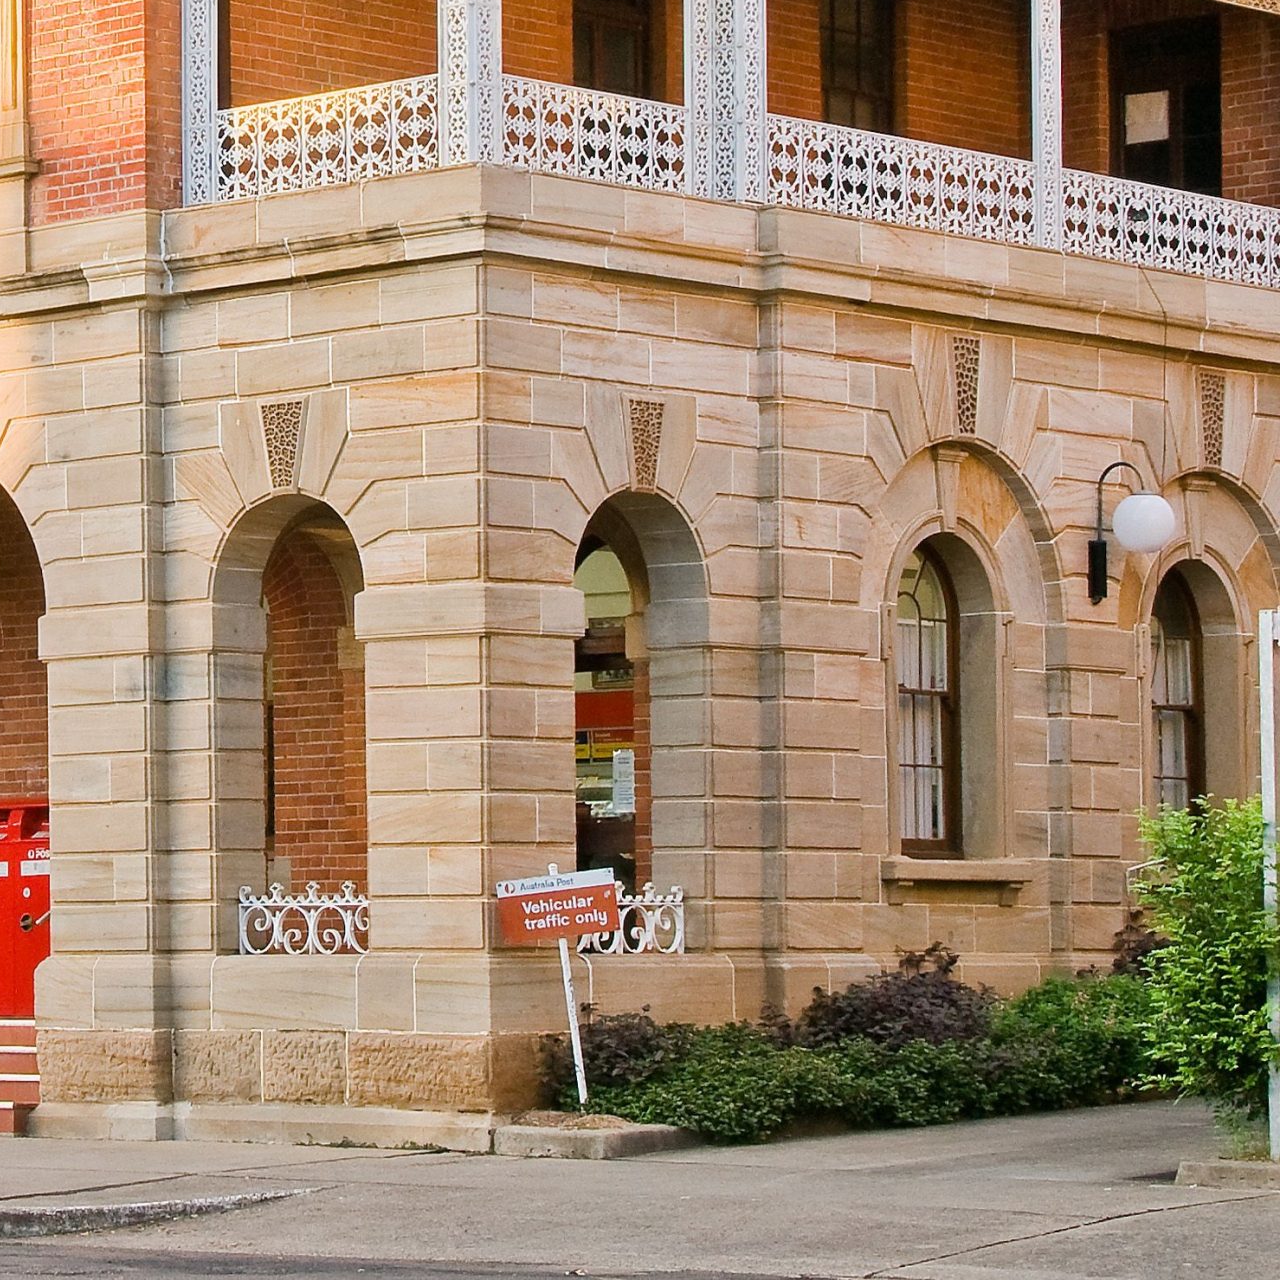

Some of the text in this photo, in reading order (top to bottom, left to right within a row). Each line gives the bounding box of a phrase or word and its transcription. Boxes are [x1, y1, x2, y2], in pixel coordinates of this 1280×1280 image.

[519, 877, 574, 892] Australia Post
[521, 896, 594, 915] Vehicular
[524, 909, 608, 931] traffic only
